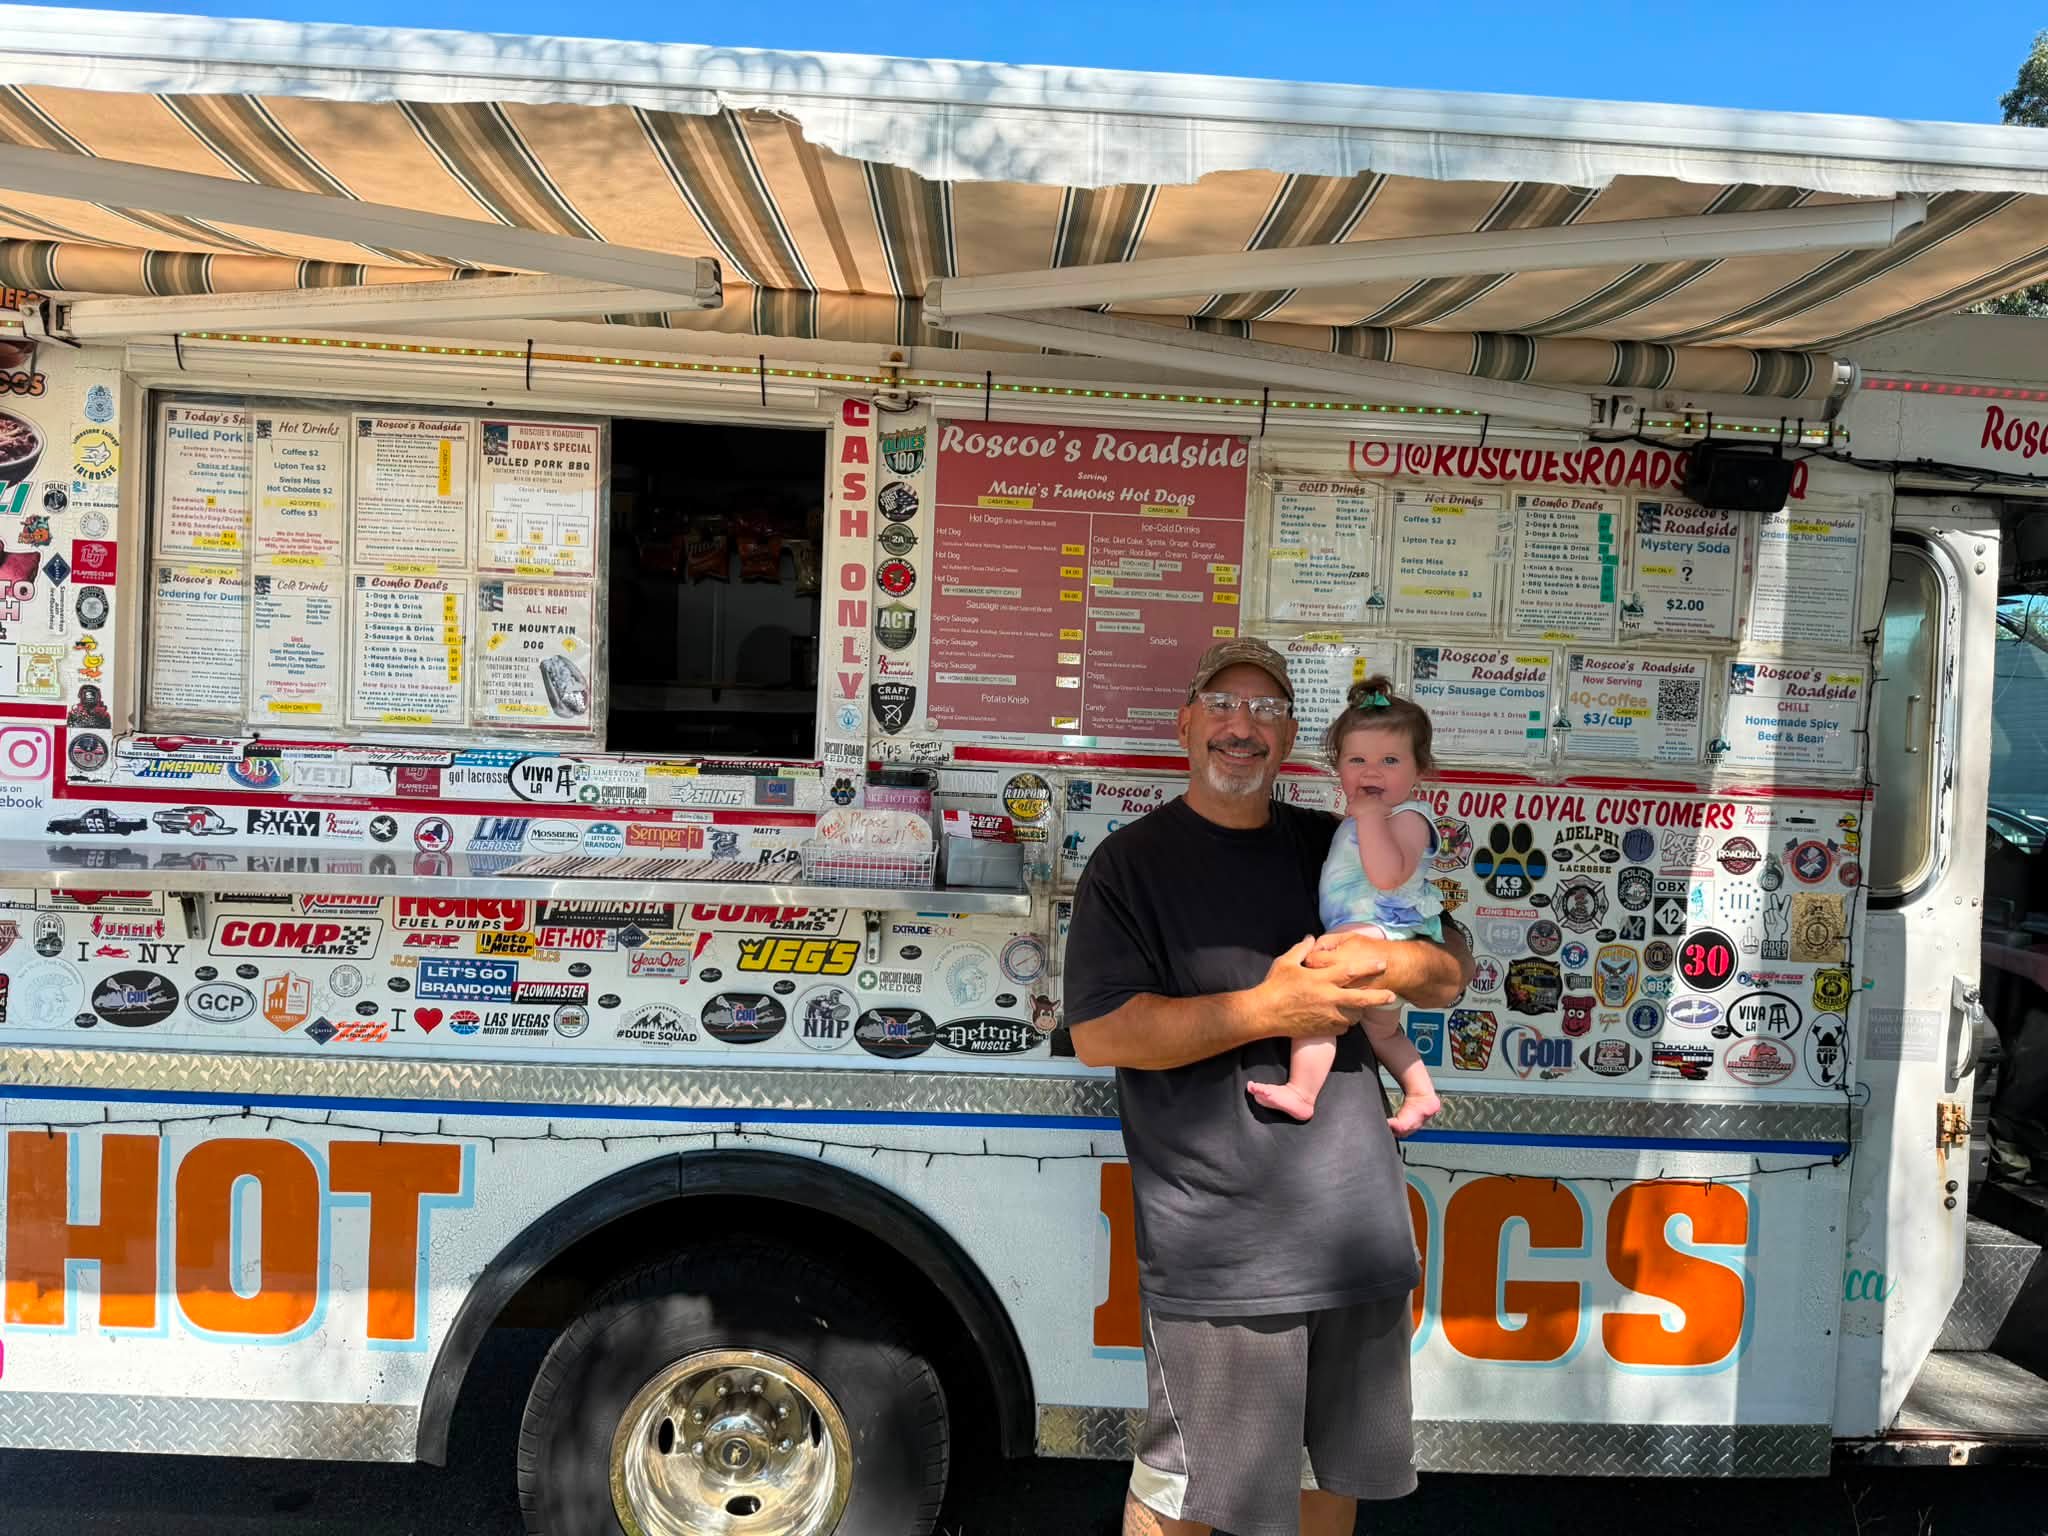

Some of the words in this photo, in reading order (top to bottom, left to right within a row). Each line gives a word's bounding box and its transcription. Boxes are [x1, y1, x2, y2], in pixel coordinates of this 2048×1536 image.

[185, 411, 228, 423] Today's
[279, 422, 299, 433] Hot
[302, 423, 340, 435] Drinks
[376, 420, 416, 430] Roscoe's
[418, 421, 462, 431] Roadside
[168, 428, 208, 440] Pulled
[214, 432, 242, 443] Pork
[282, 448, 307, 456] Coffee
[309, 449, 319, 457] $2
[511, 440, 549, 450] TODAY'S
[553, 442, 592, 453] SPECIAL
[939, 424, 1083, 464] Roscoe's
[1091, 432, 1248, 469] Roadside
[274, 462, 298, 471] Lipton
[316, 463, 327, 471] $2
[487, 457, 529, 467] PULLED
[534, 460, 563, 469] PORK
[568, 461, 590, 470] BBQ
[840, 398, 870, 538] CASH
[892, 452, 915, 472] 100
[279, 476, 301, 484] Swiss
[303, 477, 321, 485] Miss
[1077, 471, 1108, 482] Serving
[44, 483, 68, 491] POLICE
[283, 486, 321, 494] Chocolate
[323, 487, 333, 495] $2
[988, 480, 1049, 499] Marie's
[1053, 484, 1115, 502] Famous
[1119, 487, 1150, 503] Hot
[1154, 490, 1197, 506] Dogs
[1424, 493, 1446, 504] Hot
[1448, 494, 1484, 506] Drinks
[308, 509, 318, 517] $3
[969, 513, 983, 523] Hot
[984, 515, 1003, 525] Dogs
[1663, 503, 1729, 521] Roscoes
[936, 527, 948, 535] Hot
[948, 528, 962, 537] Dog
[1664, 520, 1738, 537] Roadside
[1640, 538, 1693, 554] Mystery
[1696, 541, 1731, 554] Soda
[172, 574, 213, 585] Roscoe's
[1681, 566, 1693, 582] ?
[371, 577, 411, 589] Combo
[413, 579, 449, 591] Deals
[157, 589, 201, 601] Ordering
[203, 590, 217, 599] for
[1666, 598, 1705, 612] $2.00
[880, 611, 913, 629] ACT
[932, 614, 951, 623] Spicy
[951, 614, 979, 624] Sausage
[492, 623, 514, 632] THE
[519, 624, 576, 635] MOUNTAIN
[837, 563, 867, 700] ONLY
[523, 640, 544, 649] DOG
[1149, 636, 1178, 647] Snacks
[1440, 648, 1509, 665] Roscoe's
[1585, 658, 1635, 671] Roscoe's
[1641, 661, 1696, 674] Roadside
[1471, 665, 1547, 682] Roadside
[1756, 665, 1822, 682] Roscoe's
[1582, 675, 1604, 685] Now
[1606, 676, 1642, 689] Serving
[877, 686, 910, 695] CRAFT
[1414, 683, 1446, 697] Spicy
[1447, 684, 1497, 698] Sausage
[1499, 686, 1546, 698] Combos
[1786, 683, 1857, 700] Roadside
[981, 694, 1007, 703] Potato
[1007, 695, 1030, 705] Knish
[1777, 701, 1810, 713] CHILI
[1583, 712, 1633, 728] $3/cup
[1745, 715, 1808, 728] Homemade
[1809, 718, 1839, 731] Spicy
[1757, 731, 1782, 742] Beef
[1784, 732, 1794, 743] &
[1796, 733, 1825, 744] Bean
[872, 740, 902, 759] Tips
[149, 759, 224, 774] LIMESTONE
[235, 759, 282, 777] OBX
[522, 765, 553, 782] VIVA
[297, 766, 346, 783] YETI
[449, 768, 465, 785] got
[467, 769, 509, 784] lacrosse
[530, 783, 542, 794] LA
[601, 785, 626, 799] CIRCUIT
[1095, 783, 1164, 800] Roscoe's
[692, 789, 745, 805] SAINTS
[259, 809, 309, 822] STAY
[1458, 792, 1507, 819] OUR
[1514, 794, 1586, 823] LOYAL
[1596, 797, 1736, 830] CUSTOMERS
[253, 822, 316, 836] SALTY
[474, 817, 529, 841] LMU
[530, 829, 579, 839] MOSSBERG
[753, 827, 781, 835] MATT'S
[630, 824, 686, 849] Semper
[1553, 825, 1620, 849] ADELPHI
[584, 841, 622, 849] BRANDON
[1717, 849, 1762, 862] ROADKILL
[1559, 863, 1612, 874] LACROSSE
[1496, 875, 1522, 889] K9
[1656, 881, 1687, 893] OBX
[1495, 888, 1523, 897] UNIT
[1480, 907, 1504, 916] LONG
[1505, 908, 1537, 918] ISLAND
[1662, 907, 1680, 925] 12
[398, 918, 439, 928] FUEL
[444, 919, 502, 929] PUMPS
[769, 919, 826, 931] CAMS
[220, 921, 341, 948] COMP
[402, 933, 461, 945] ARP
[493, 933, 527, 943] Auto
[534, 927, 607, 949] JET-HOT
[301, 944, 359, 955] CAMS
[490, 943, 533, 954] Meter
[1762, 941, 1788, 949] GOOD
[78, 941, 90, 962] I
[137, 943, 186, 964] NY
[741, 938, 861, 975] JEG'S
[1683, 943, 1729, 977] 30
[427, 966, 476, 978] LET'S
[479, 967, 508, 979] GO
[878, 971, 902, 985] CIRCUIT
[902, 972, 922, 985] BOARD
[421, 982, 513, 995] BRANDON!
[878, 984, 922, 993] MEDICS
[1472, 977, 1496, 991] DIXIE
[514, 983, 586, 1001] FLOWMASTER
[197, 993, 245, 1012] GCP
[484, 1012, 509, 1027] LAS
[511, 1013, 551, 1028] VEGAS
[1738, 1005, 1766, 1021] VIVA
[482, 1027, 509, 1036] MOTOR
[510, 1028, 549, 1037] SPEEDWAY
[803, 1018, 850, 1039] NHP
[1745, 1021, 1757, 1032] LA
[616, 1030, 655, 1041] #DUDE
[657, 1031, 698, 1042] SQUAD
[948, 1020, 1033, 1050] Detroit
[970, 1040, 1012, 1051] MUSCLE
[1816, 1053, 1838, 1065] UP
[4, 1130, 472, 1347] HOT
[1093, 1160, 1756, 1368] GS
